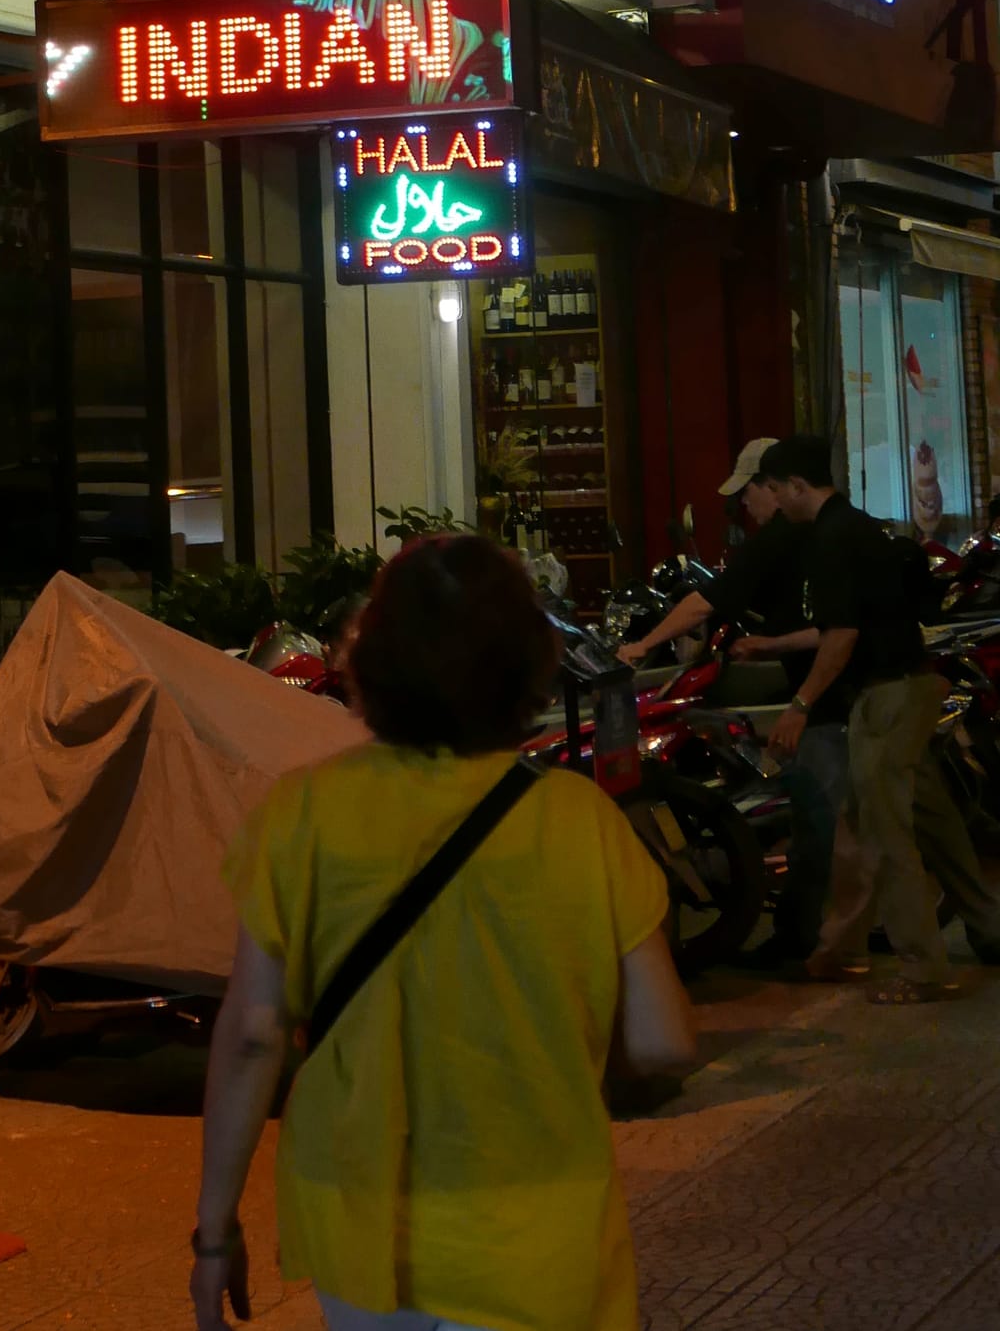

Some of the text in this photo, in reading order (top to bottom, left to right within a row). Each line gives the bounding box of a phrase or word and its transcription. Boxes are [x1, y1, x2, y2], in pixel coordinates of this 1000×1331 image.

[119, 0, 452, 103] INDIAN
[355, 131, 504, 175] HALAL
[371, 174, 483, 240] حلال
[365, 235, 503, 268] FOOD
